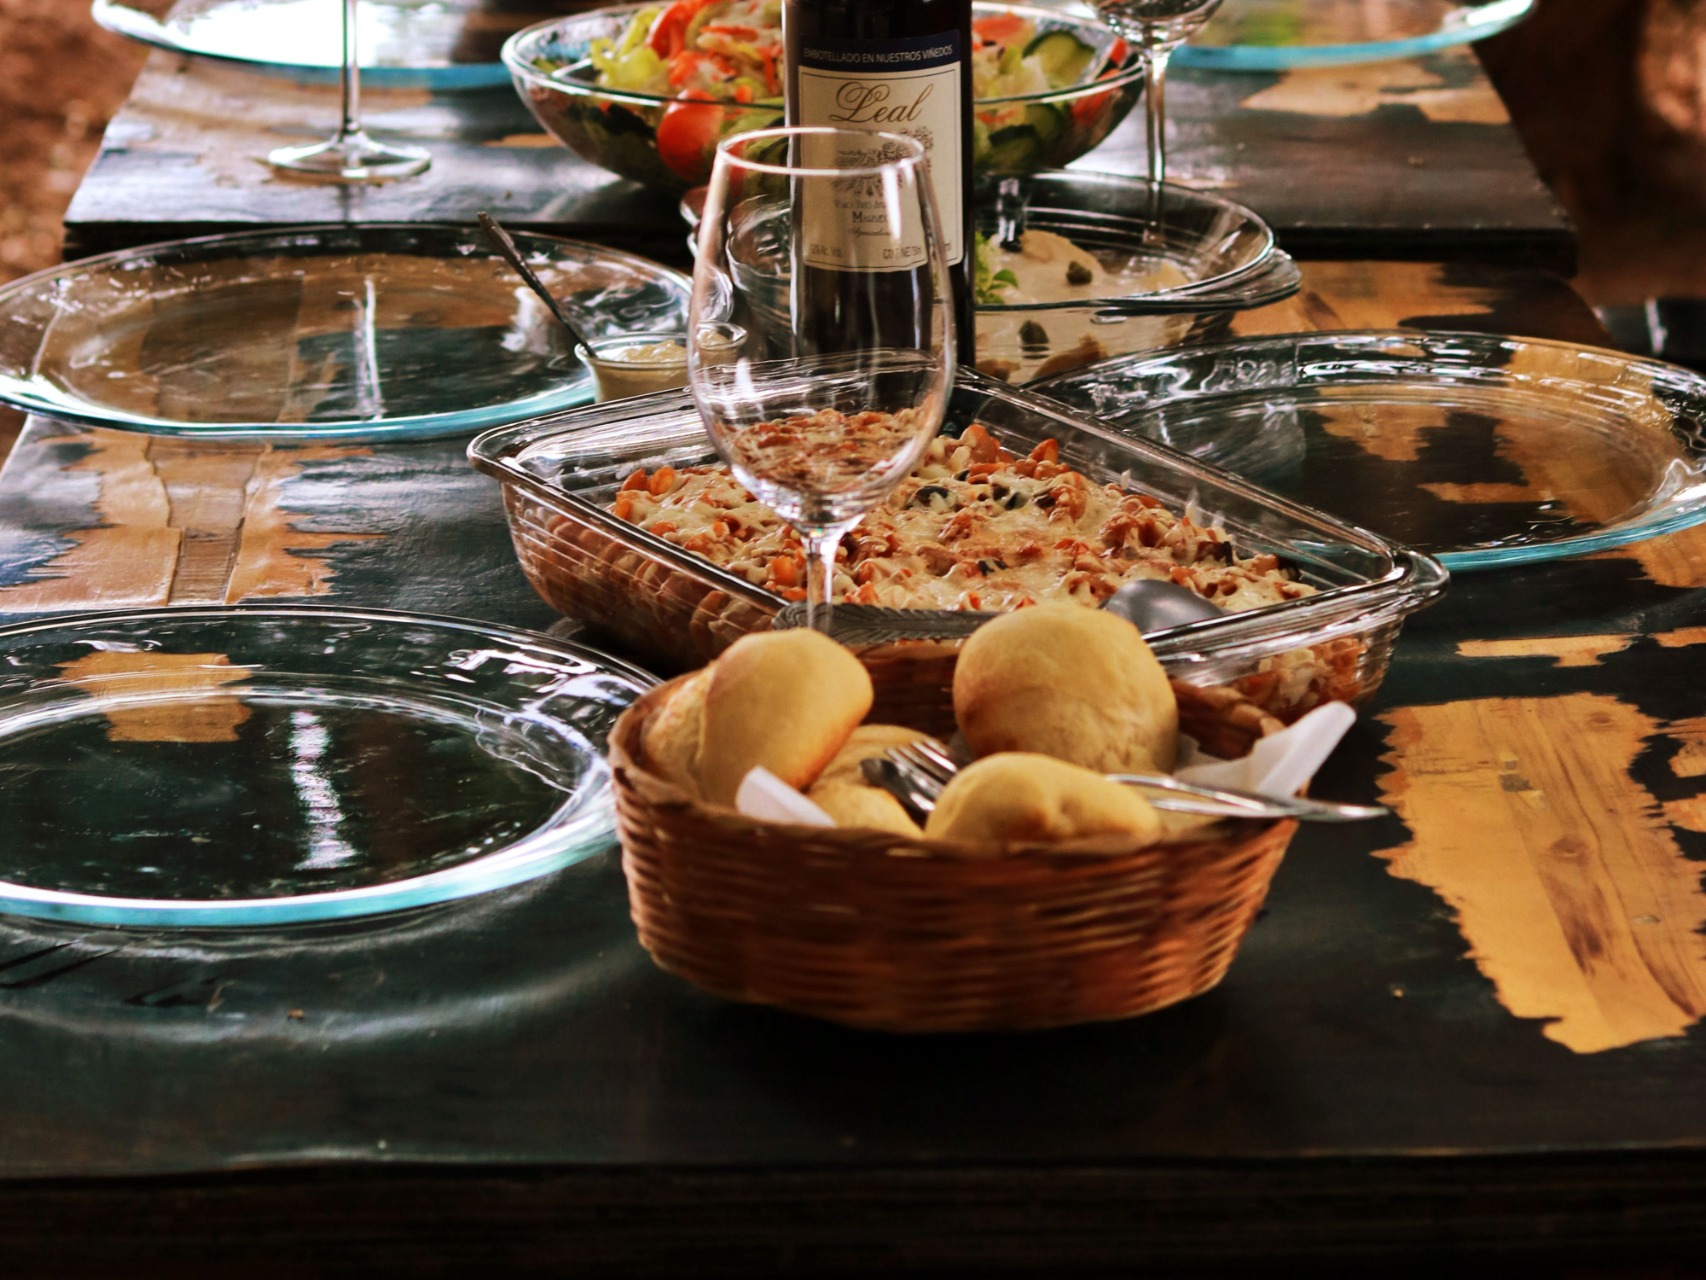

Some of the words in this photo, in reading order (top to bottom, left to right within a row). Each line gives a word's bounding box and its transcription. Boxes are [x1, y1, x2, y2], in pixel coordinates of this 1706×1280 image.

[804, 47, 861, 63] EMBOTELLADO
[862, 53, 875, 63] EN
[876, 50, 922, 63] NUESTROS
[922, 44, 953, 60] VIÑEDOS
[829, 81, 934, 124] Leal
